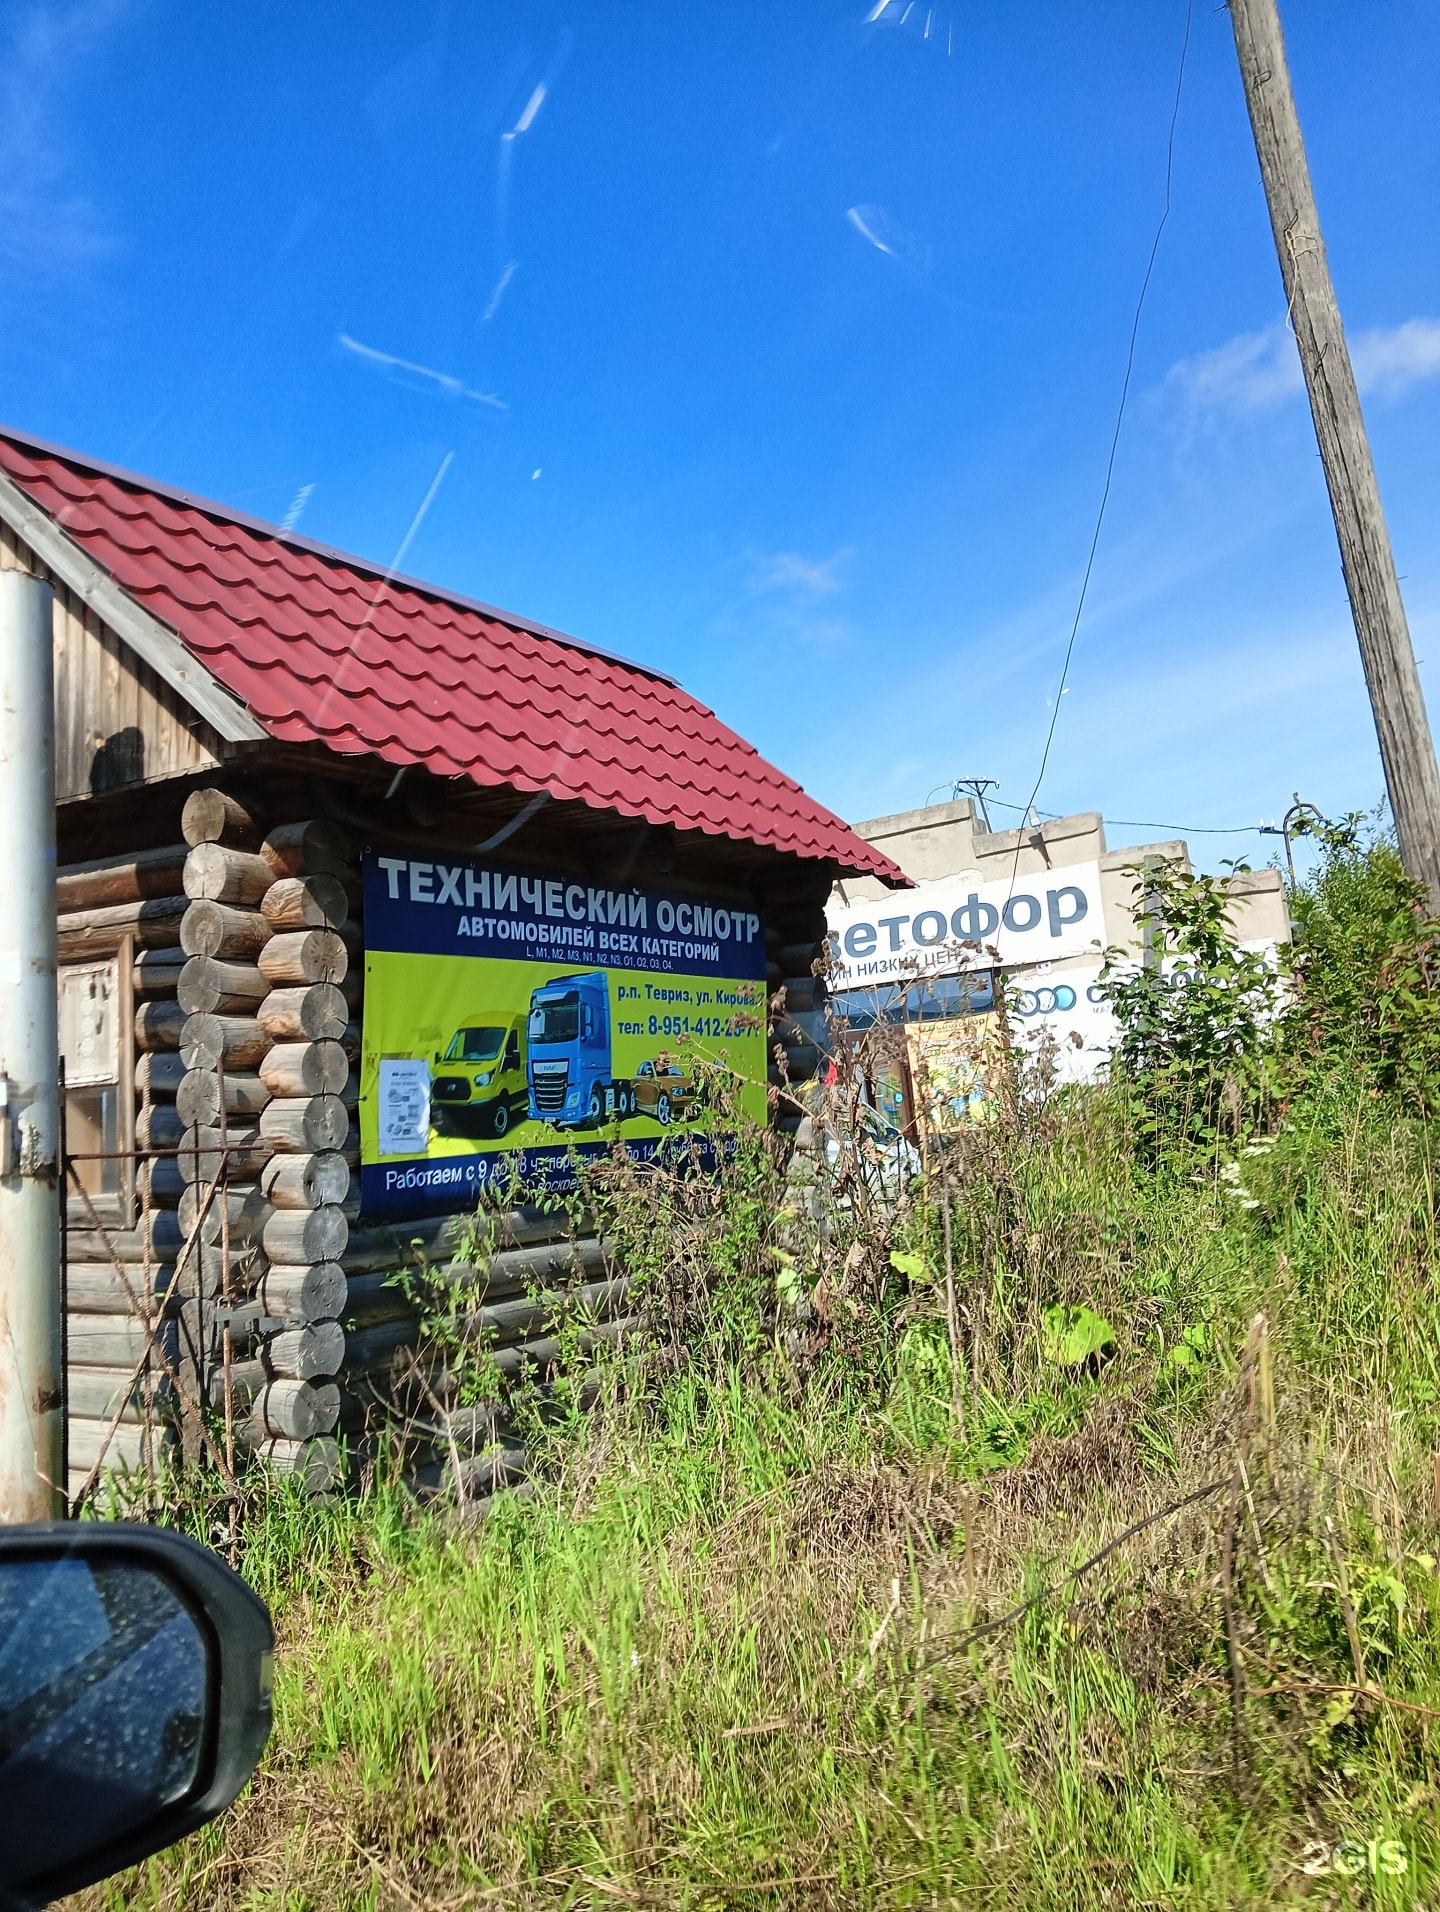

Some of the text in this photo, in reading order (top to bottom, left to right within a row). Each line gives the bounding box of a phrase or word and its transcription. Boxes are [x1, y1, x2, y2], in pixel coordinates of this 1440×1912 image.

[378, 857, 760, 943] ТЕХНИЧЕСКИЙ ОСМОТР
[457, 915, 719, 962] АВТОМОБИЛЕЙ ВСЕХ КАТЕГОРИЙ
[617, 985, 641, 1001] р.п.
[645, 984, 693, 1005] Тевриз,
[696, 991, 713, 1006] ул.
[617, 1022, 644, 1034] тел:
[386, 1167, 462, 1191] Работаем
[465, 1167, 475, 1181] с
[477, 1160, 488, 1180] 9
